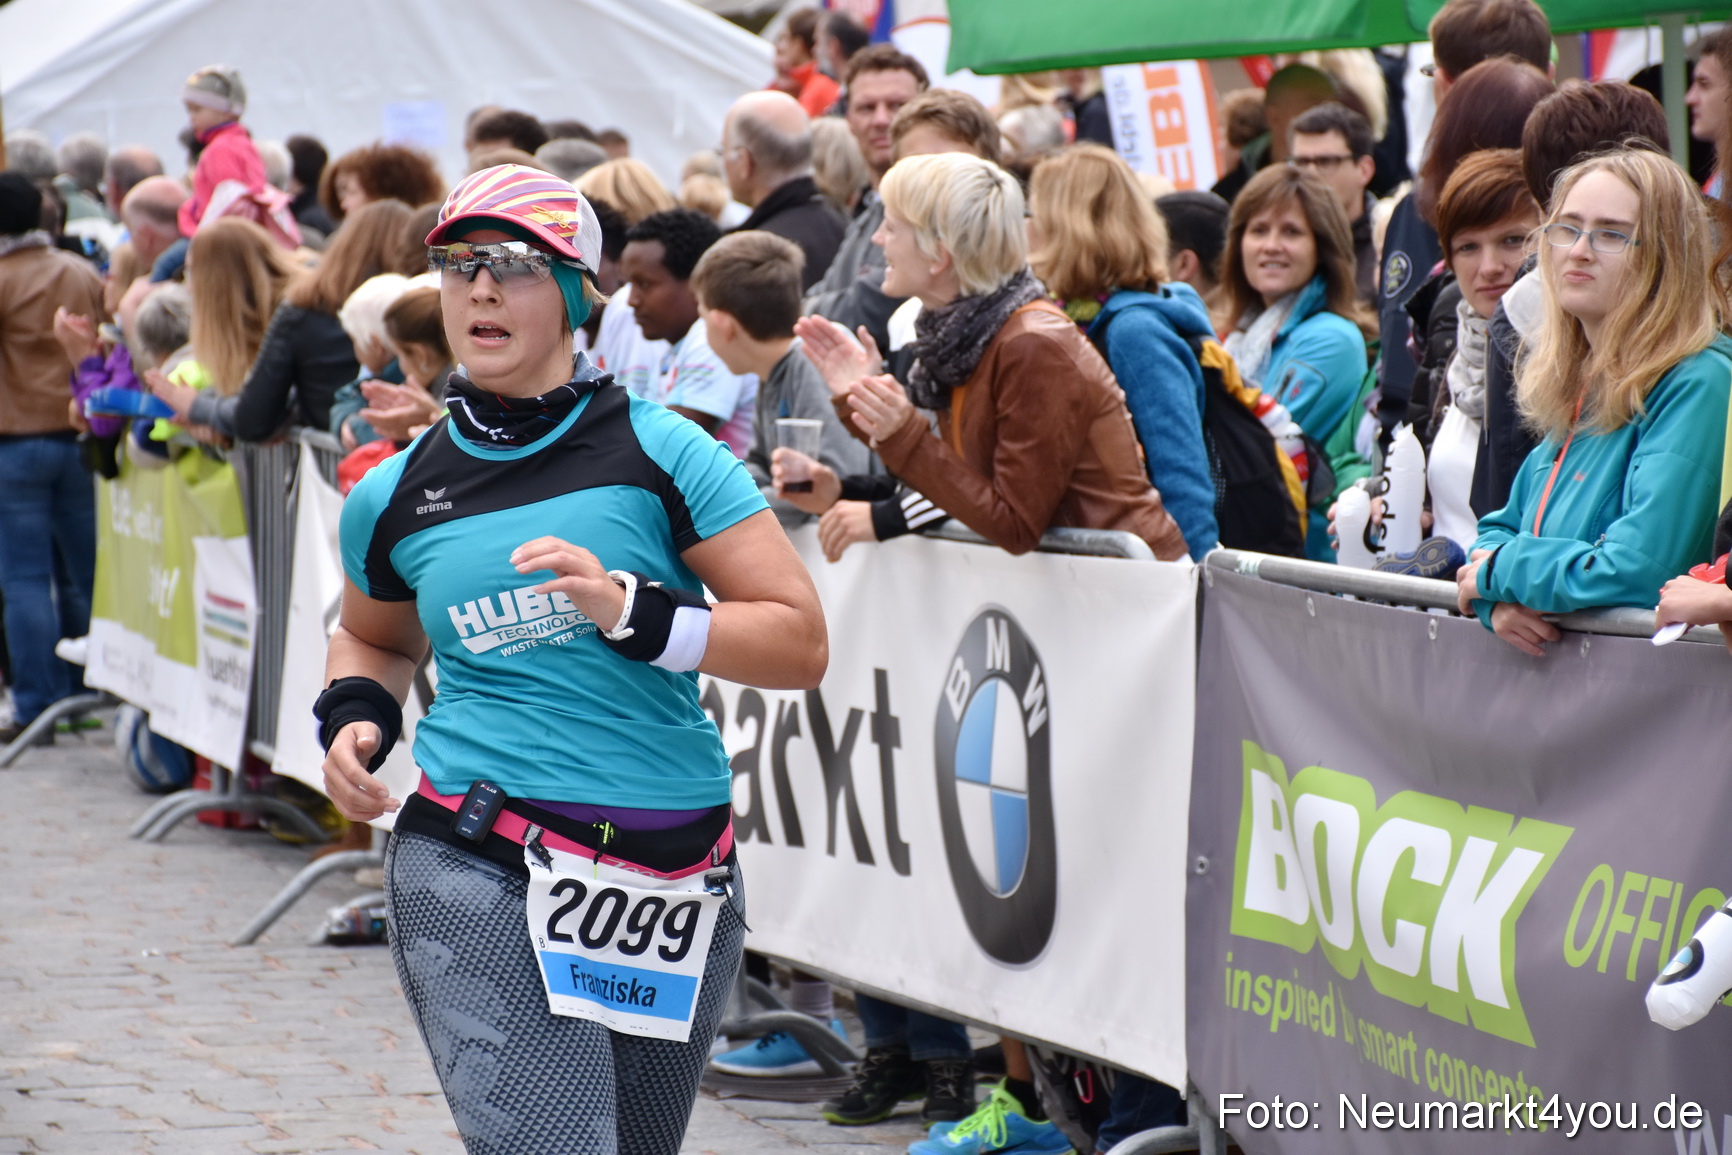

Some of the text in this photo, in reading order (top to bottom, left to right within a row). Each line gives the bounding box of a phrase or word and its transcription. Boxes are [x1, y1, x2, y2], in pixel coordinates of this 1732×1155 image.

[416, 501, 453, 515] erima
[500, 639, 539, 658] WASTE
[944, 617, 1047, 739] BMW
[480, 784, 497, 794] POLAR
[1242, 767, 1547, 1011] BOCK
[538, 936, 546, 949] B
[547, 877, 702, 963] 2099
[569, 963, 657, 1008] Franziska
[1225, 952, 1336, 1038] inspired
[1358, 1018, 1420, 1085] smart
[1424, 1047, 1548, 1136] concepts
